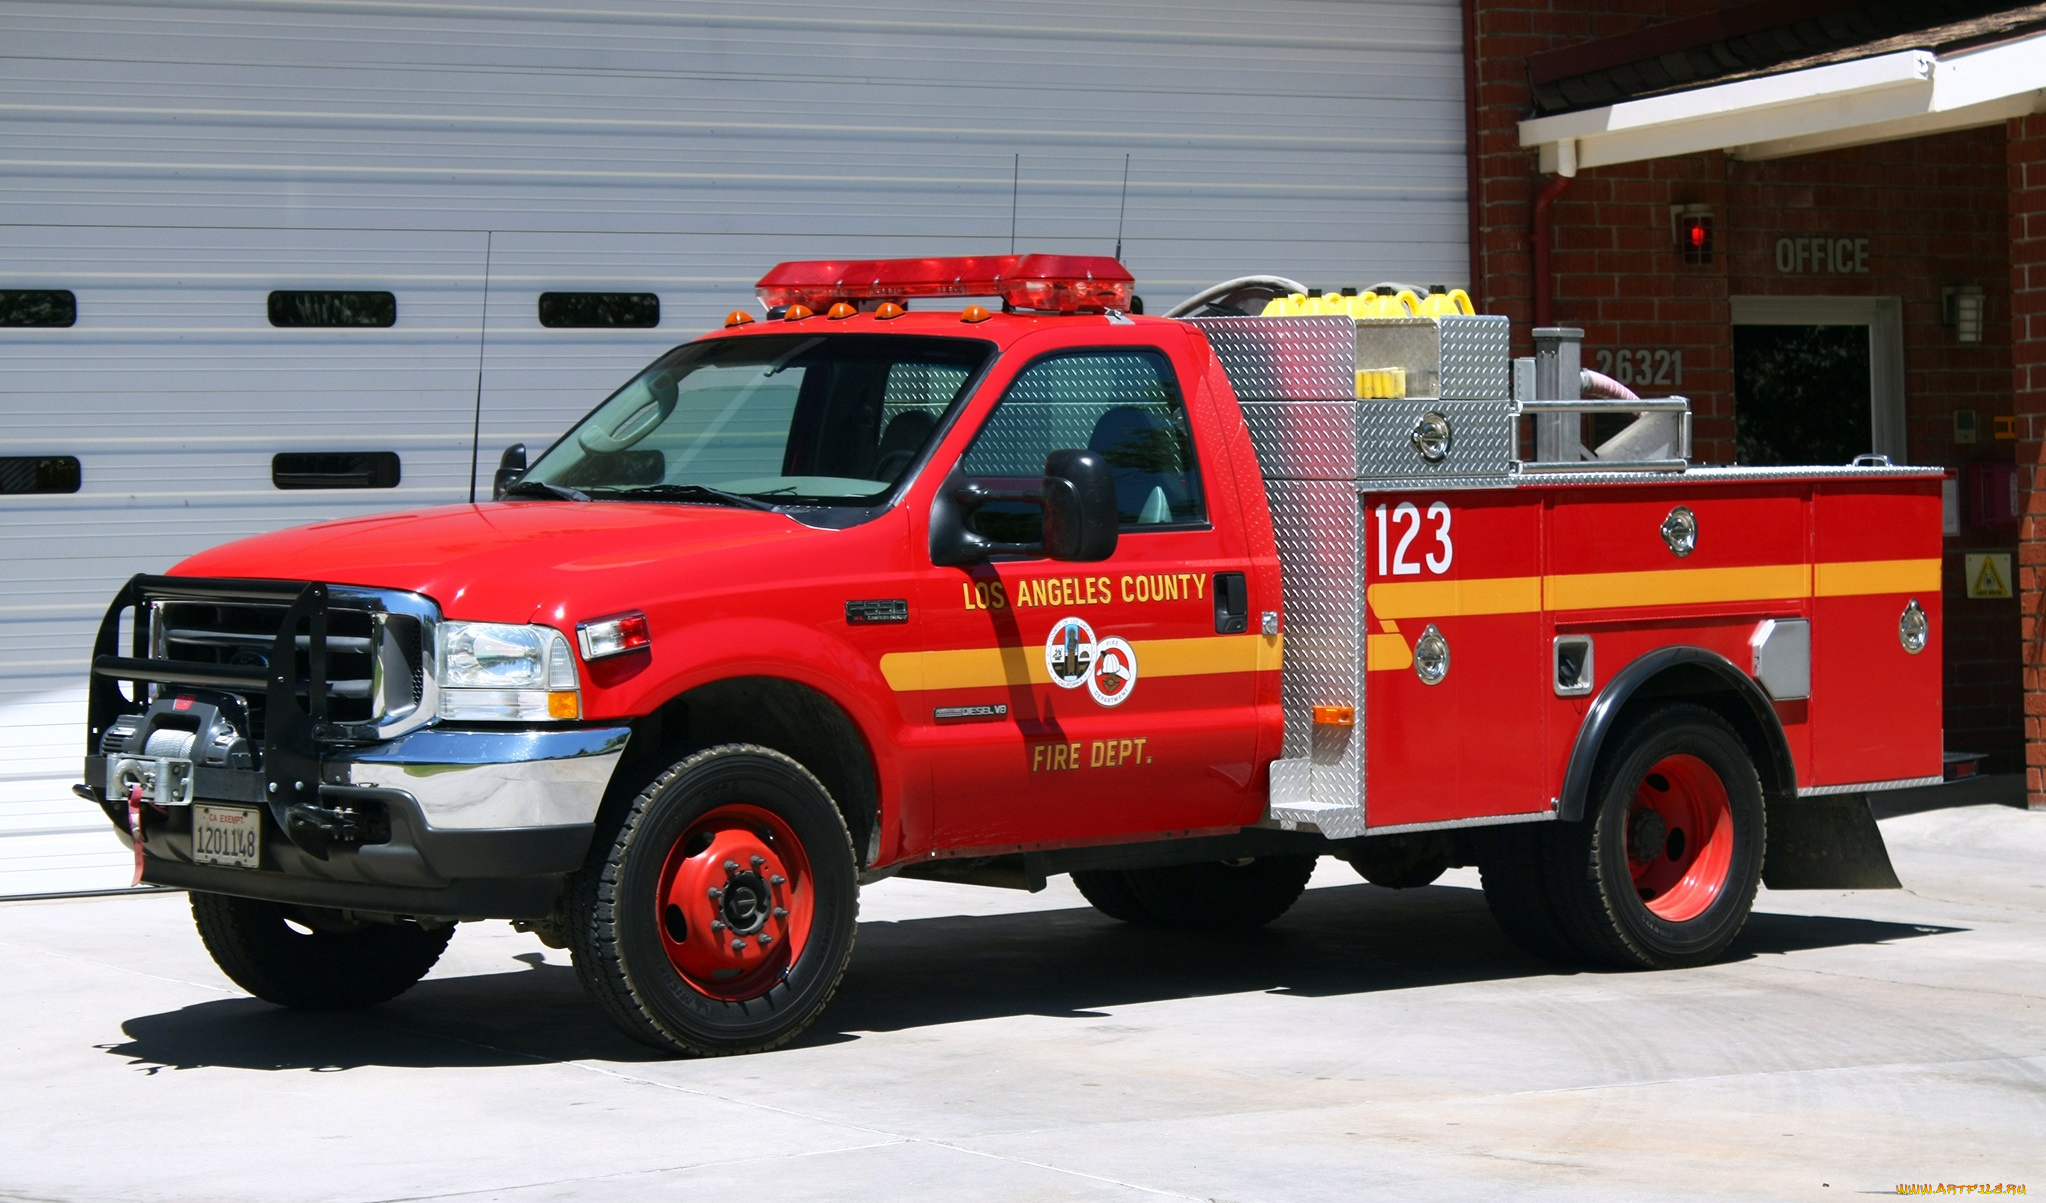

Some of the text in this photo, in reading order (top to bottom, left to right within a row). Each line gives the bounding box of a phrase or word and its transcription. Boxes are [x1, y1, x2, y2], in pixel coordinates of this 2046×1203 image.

[1775, 237, 1870, 274] OFFICE
[1595, 348, 1683, 387] 26321
[1375, 500, 1454, 577] 123
[962, 573, 1207, 611] LOS ANGELES COUNTY
[962, 706, 994, 716] DIESEL
[994, 704, 1007, 714] V8
[1093, 688, 1130, 703] DEPARTMENT
[1032, 737, 1153, 772] FIRE DEPT.
[208, 813, 245, 824] CA EXEMPT
[197, 826, 256, 858] 1201148
